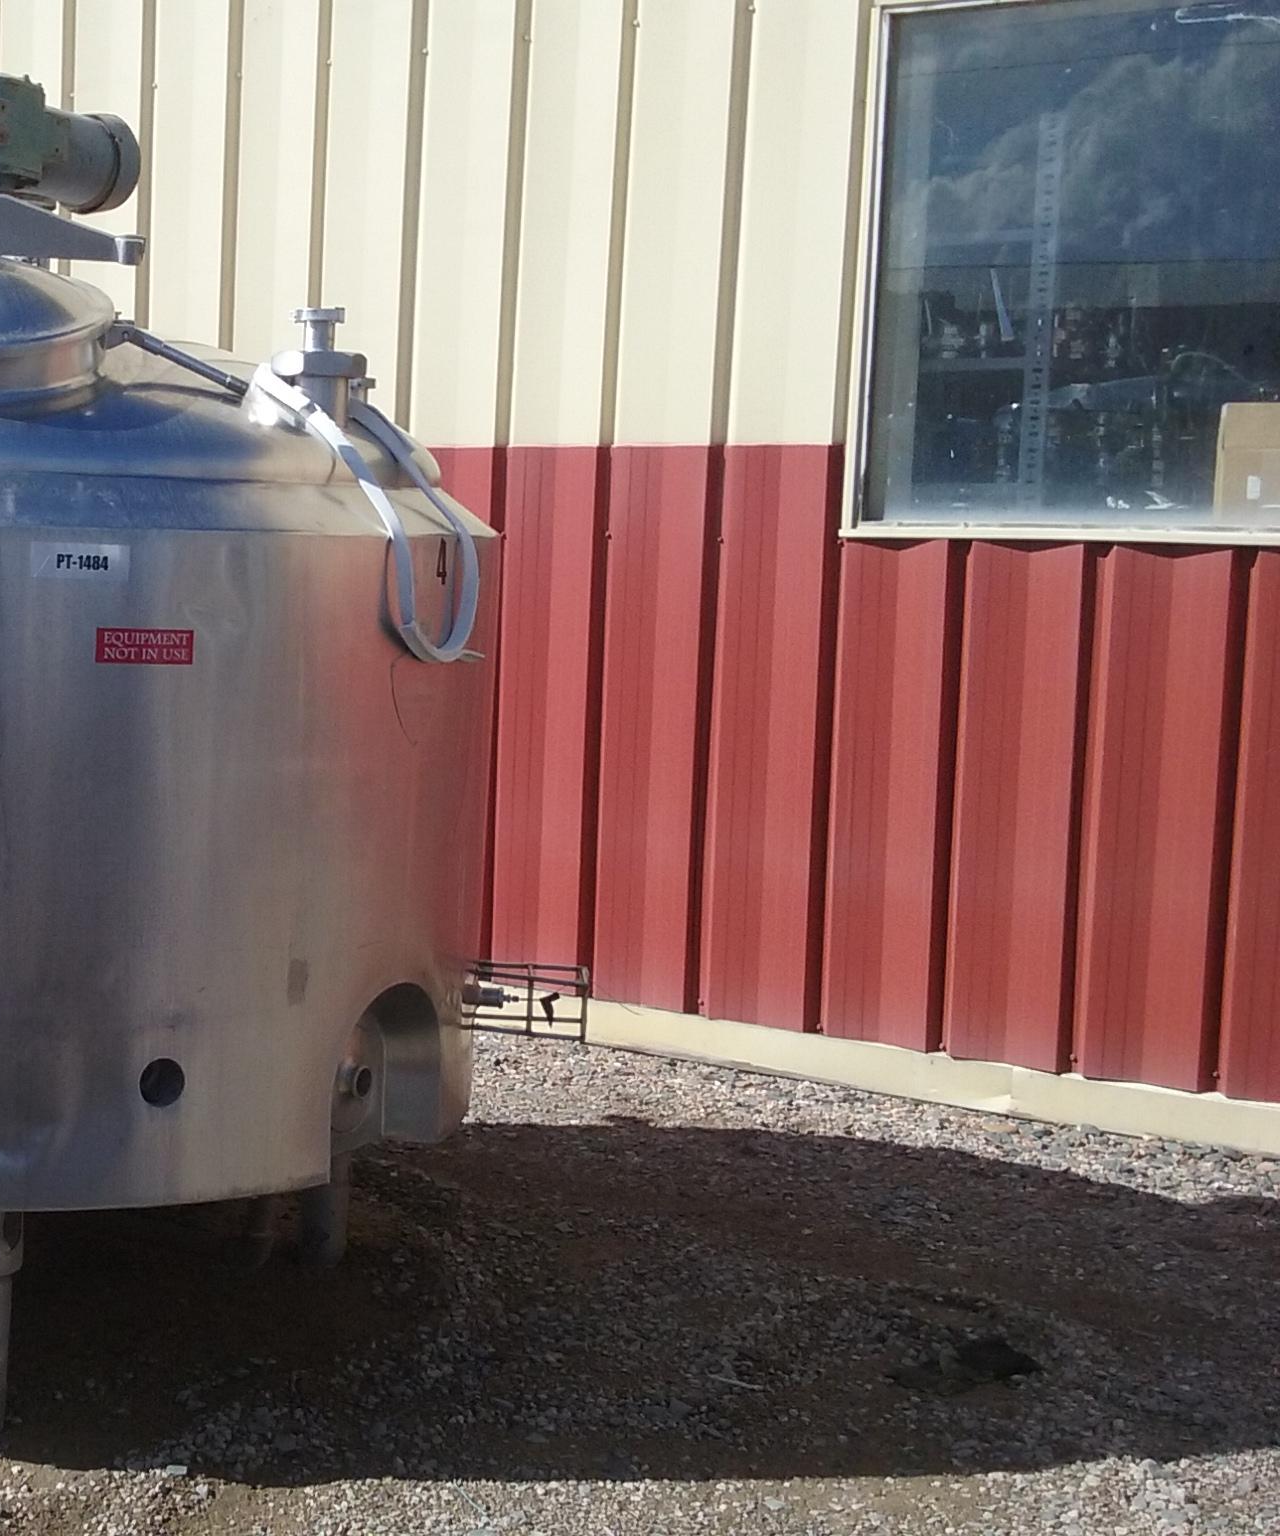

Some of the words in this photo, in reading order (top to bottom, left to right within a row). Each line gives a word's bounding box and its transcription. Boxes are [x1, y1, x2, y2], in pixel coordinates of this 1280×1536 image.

[56, 553, 109, 571] PT-1484
[103, 632, 189, 646] EQUIPMENT
[103, 647, 138, 660] NOT
[142, 648, 158, 660] IN
[163, 648, 188, 660] USE
